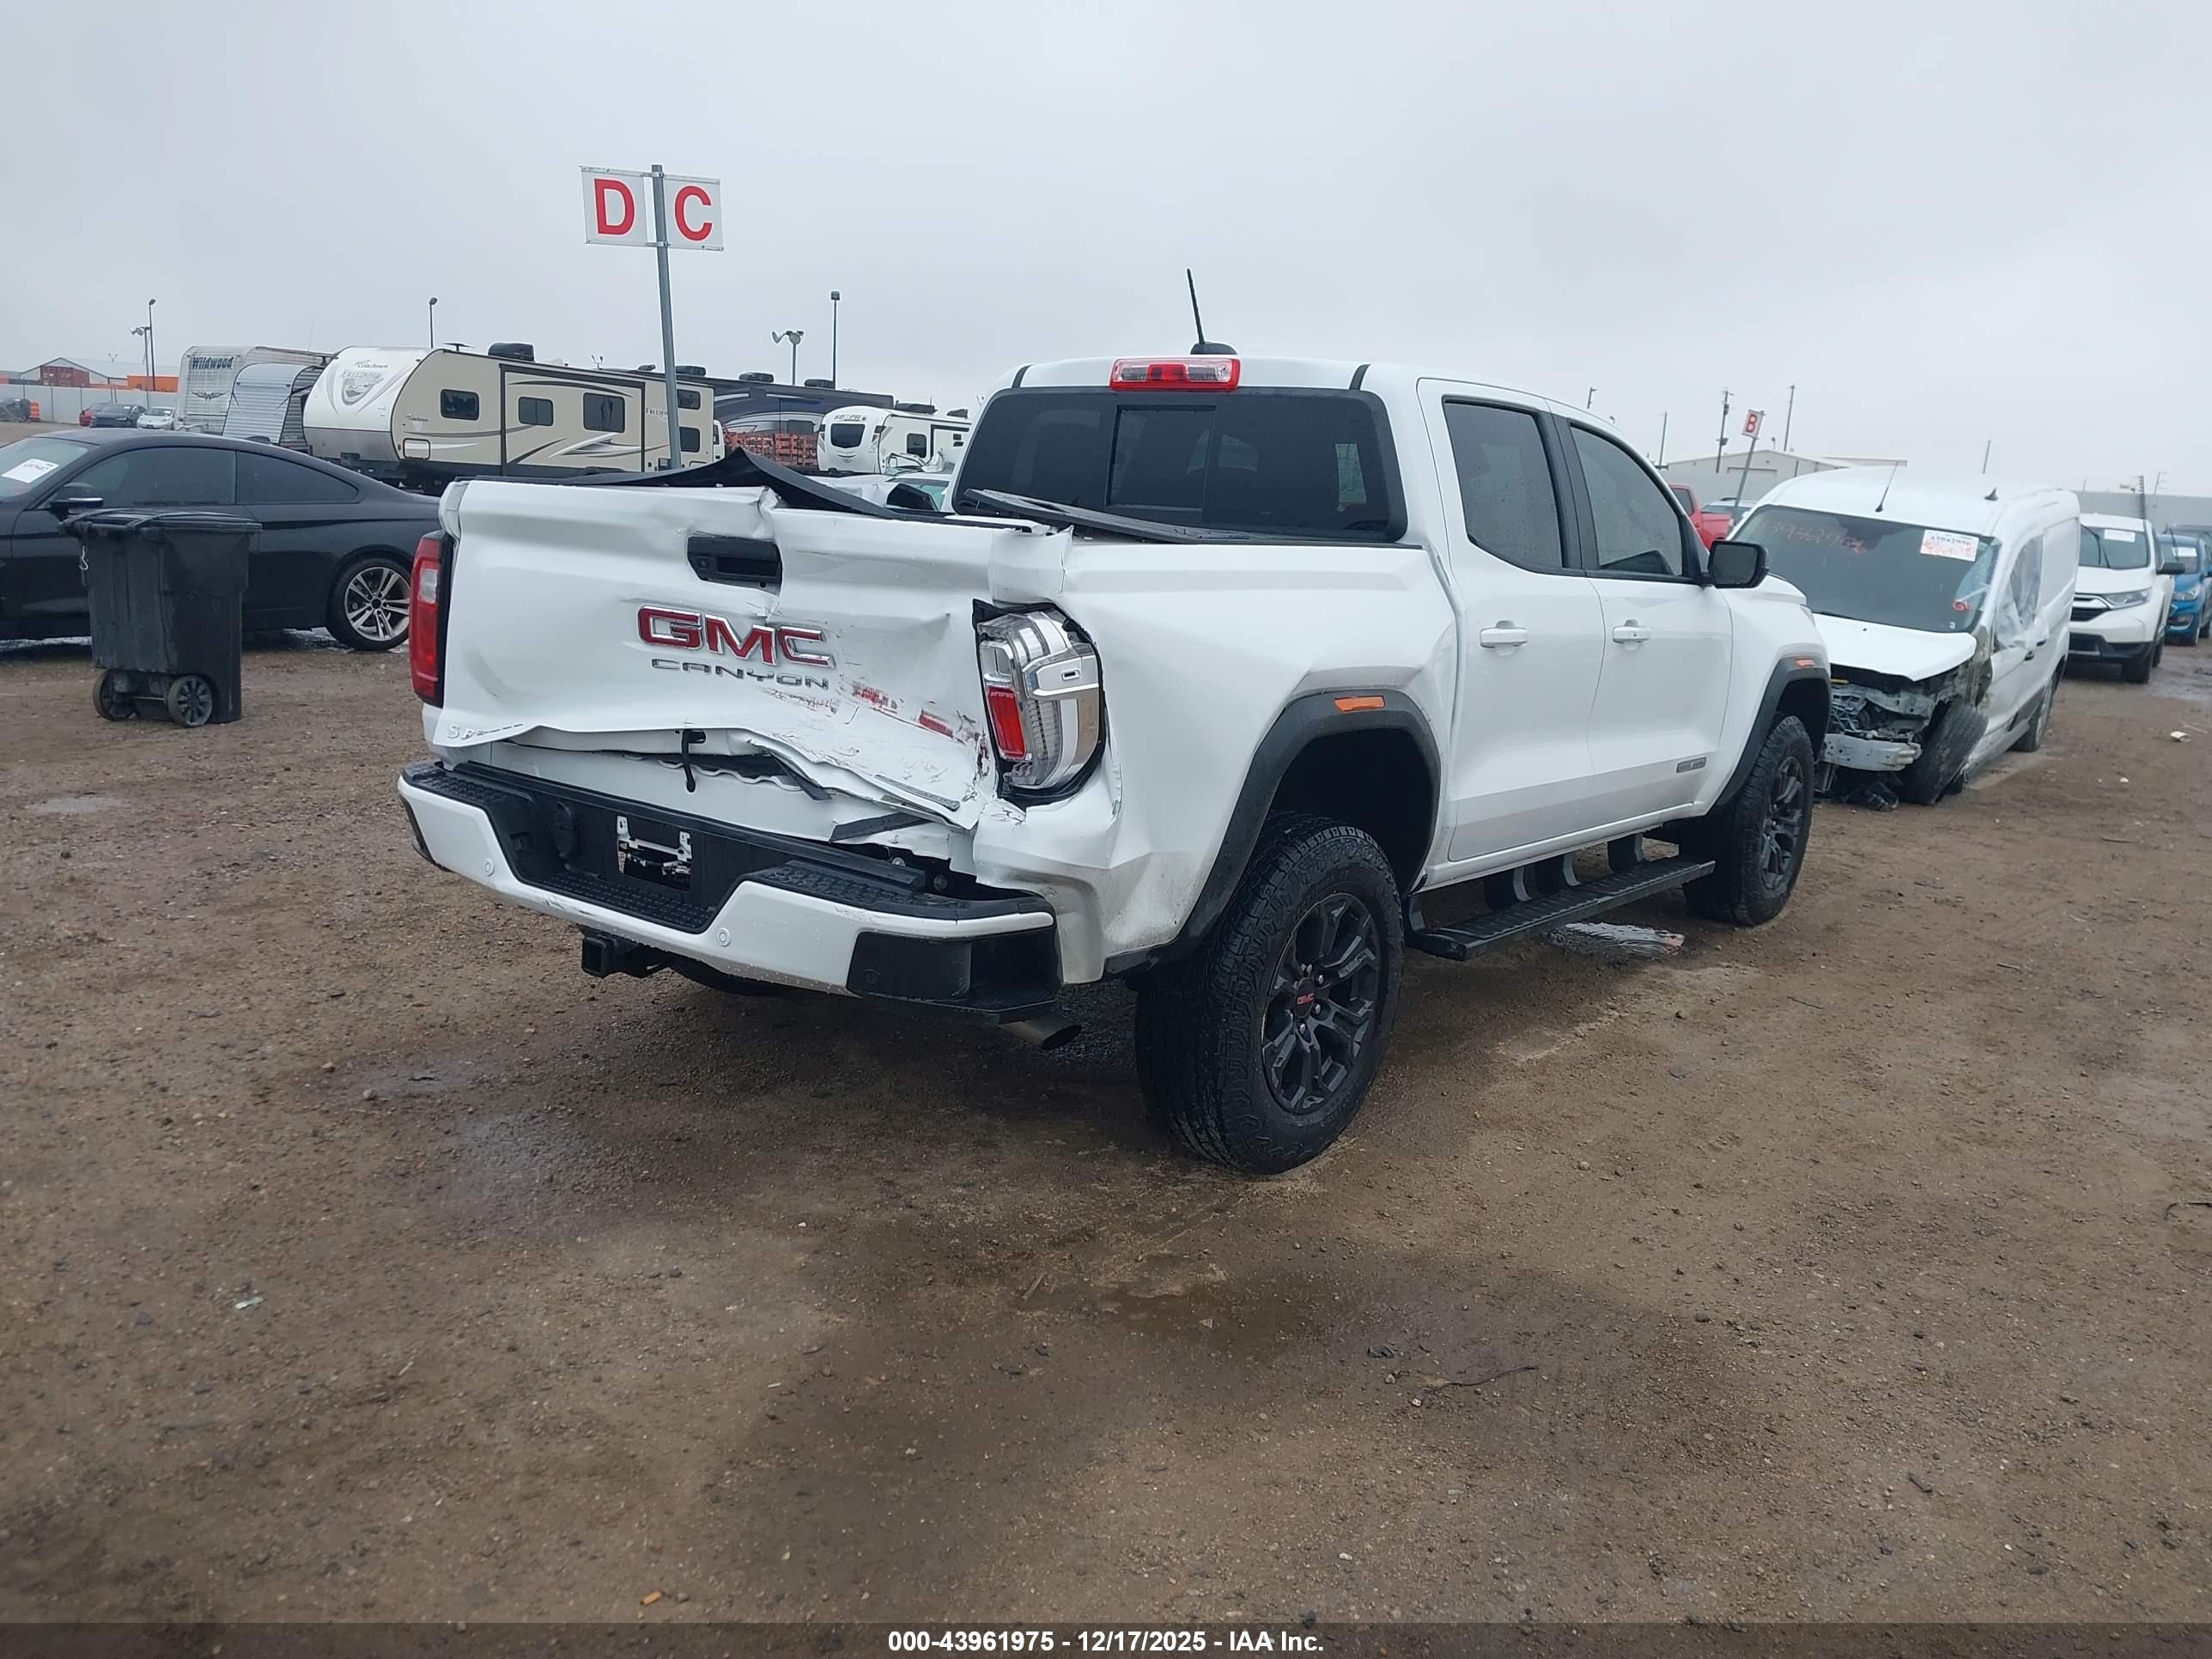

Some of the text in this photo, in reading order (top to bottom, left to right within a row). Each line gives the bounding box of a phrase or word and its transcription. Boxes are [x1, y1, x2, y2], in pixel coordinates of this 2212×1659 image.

[594, 178, 635, 235] D
[674, 185, 713, 241] C
[191, 356, 234, 371] Wildwood
[1745, 413, 1758, 433] B
[637, 604, 837, 668] GMC
[651, 658, 830, 690] CANYON
